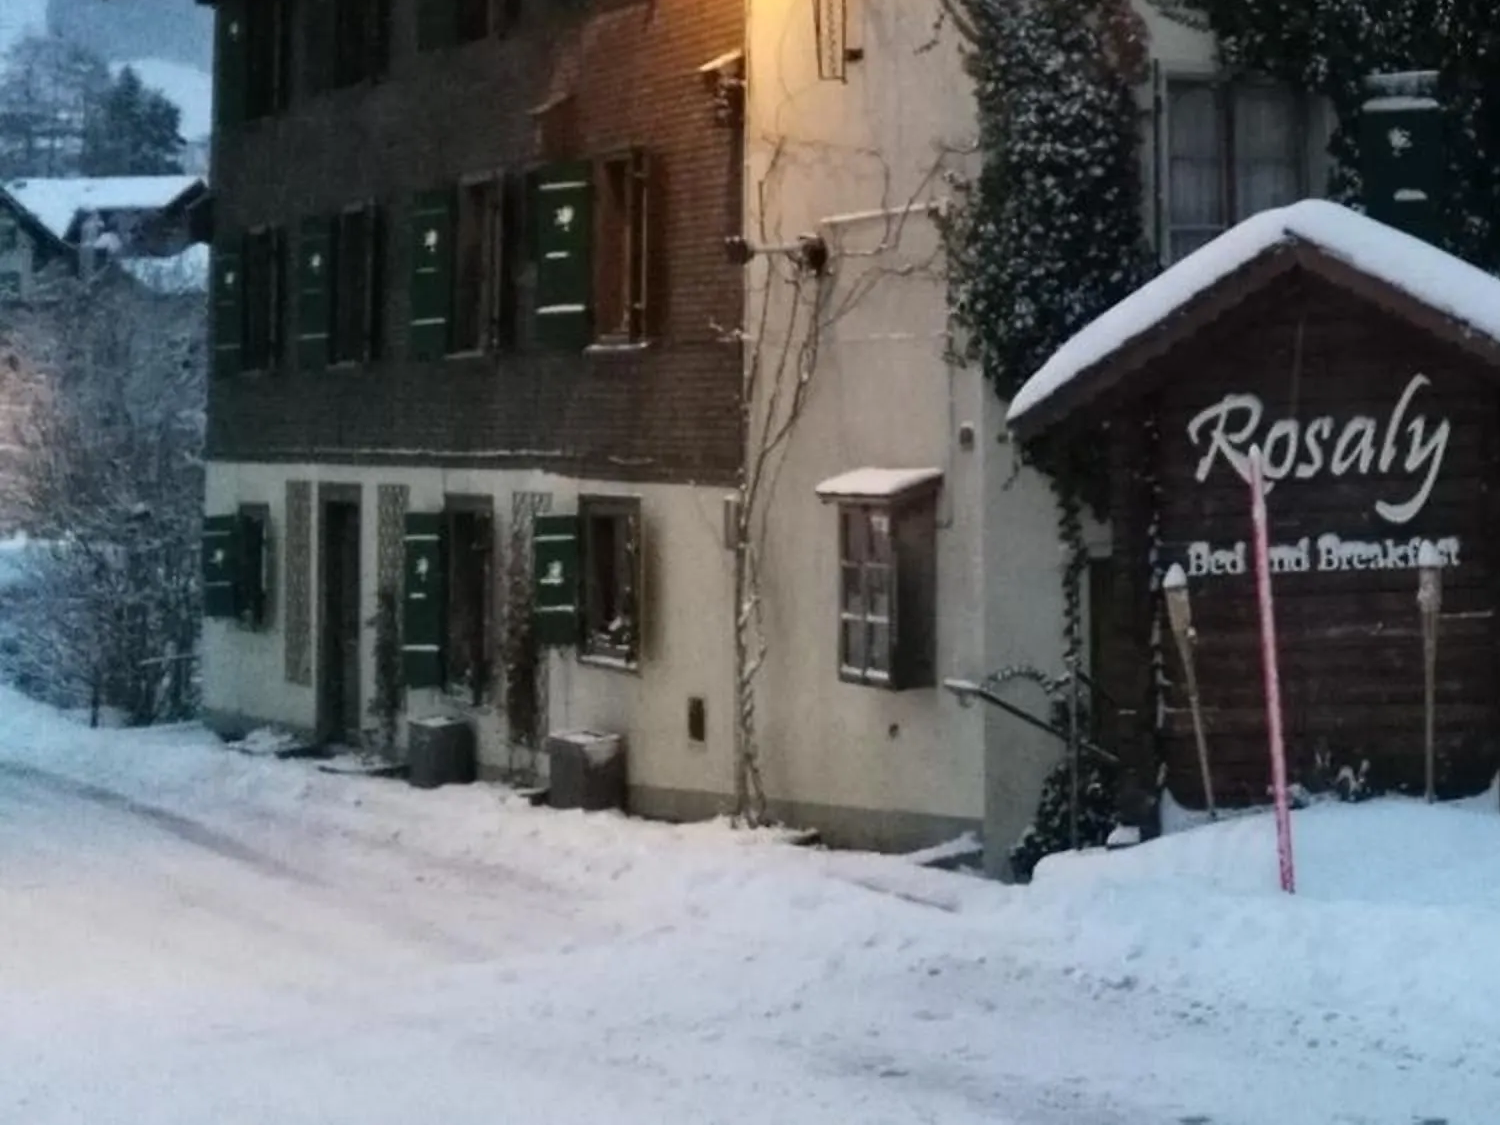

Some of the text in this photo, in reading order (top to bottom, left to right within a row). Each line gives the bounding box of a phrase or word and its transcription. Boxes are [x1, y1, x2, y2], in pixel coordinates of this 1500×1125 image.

[1187, 372, 1451, 524] Rosaly
[1188, 532, 1461, 576] Bed nd Breakfst
